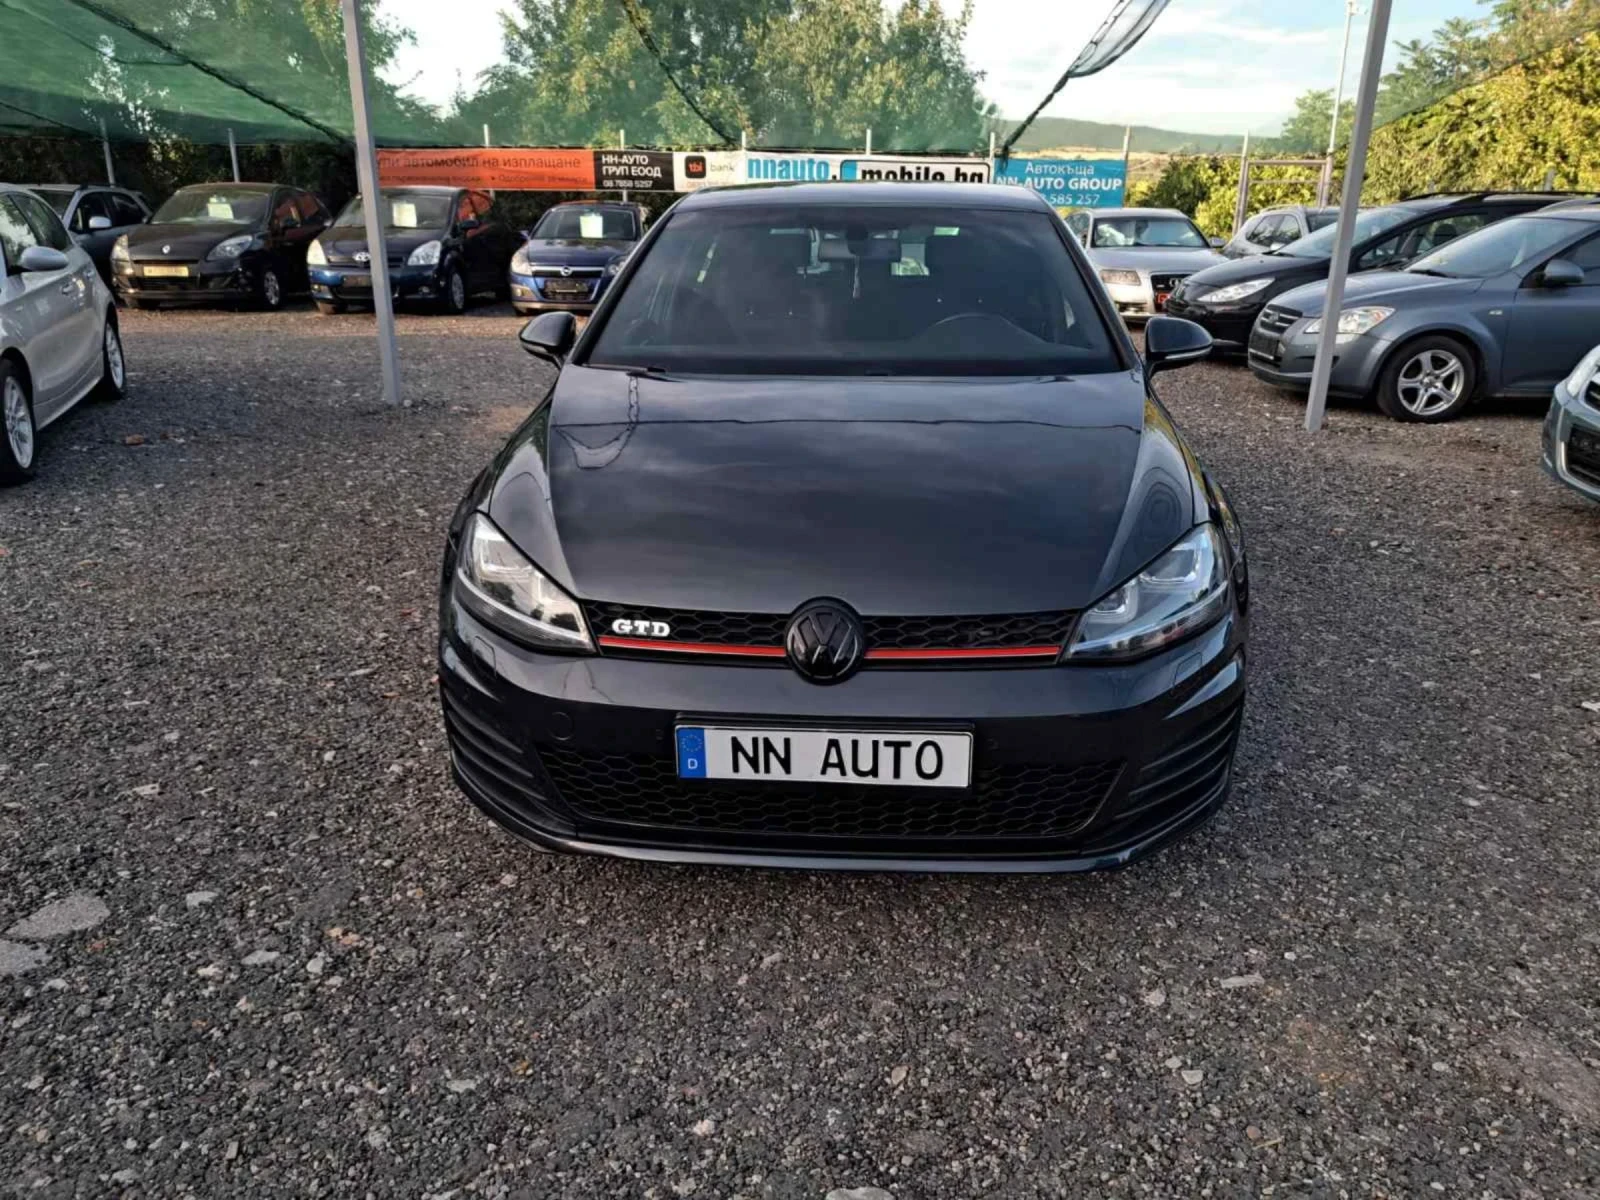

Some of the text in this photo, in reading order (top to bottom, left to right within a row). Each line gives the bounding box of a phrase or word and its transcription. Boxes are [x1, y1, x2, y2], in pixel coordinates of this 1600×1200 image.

[404, 155, 478, 168] автомобил
[483, 157, 498, 168] на
[503, 157, 581, 169] изплащане
[601, 154, 649, 165] НН-АУТО
[710, 161, 735, 172] bank
[602, 165, 662, 178] ГРУП ЕООД
[861, 165, 984, 184] mobilebg
[1024, 161, 1095, 176] Автокъща
[1068, 177, 1122, 191] GROUP
[1049, 193, 1073, 206] 585
[1076, 193, 1101, 206] 257
[611, 618, 670, 637] GTD
[687, 758, 699, 769] D
[731, 736, 944, 780] NN AUTO
